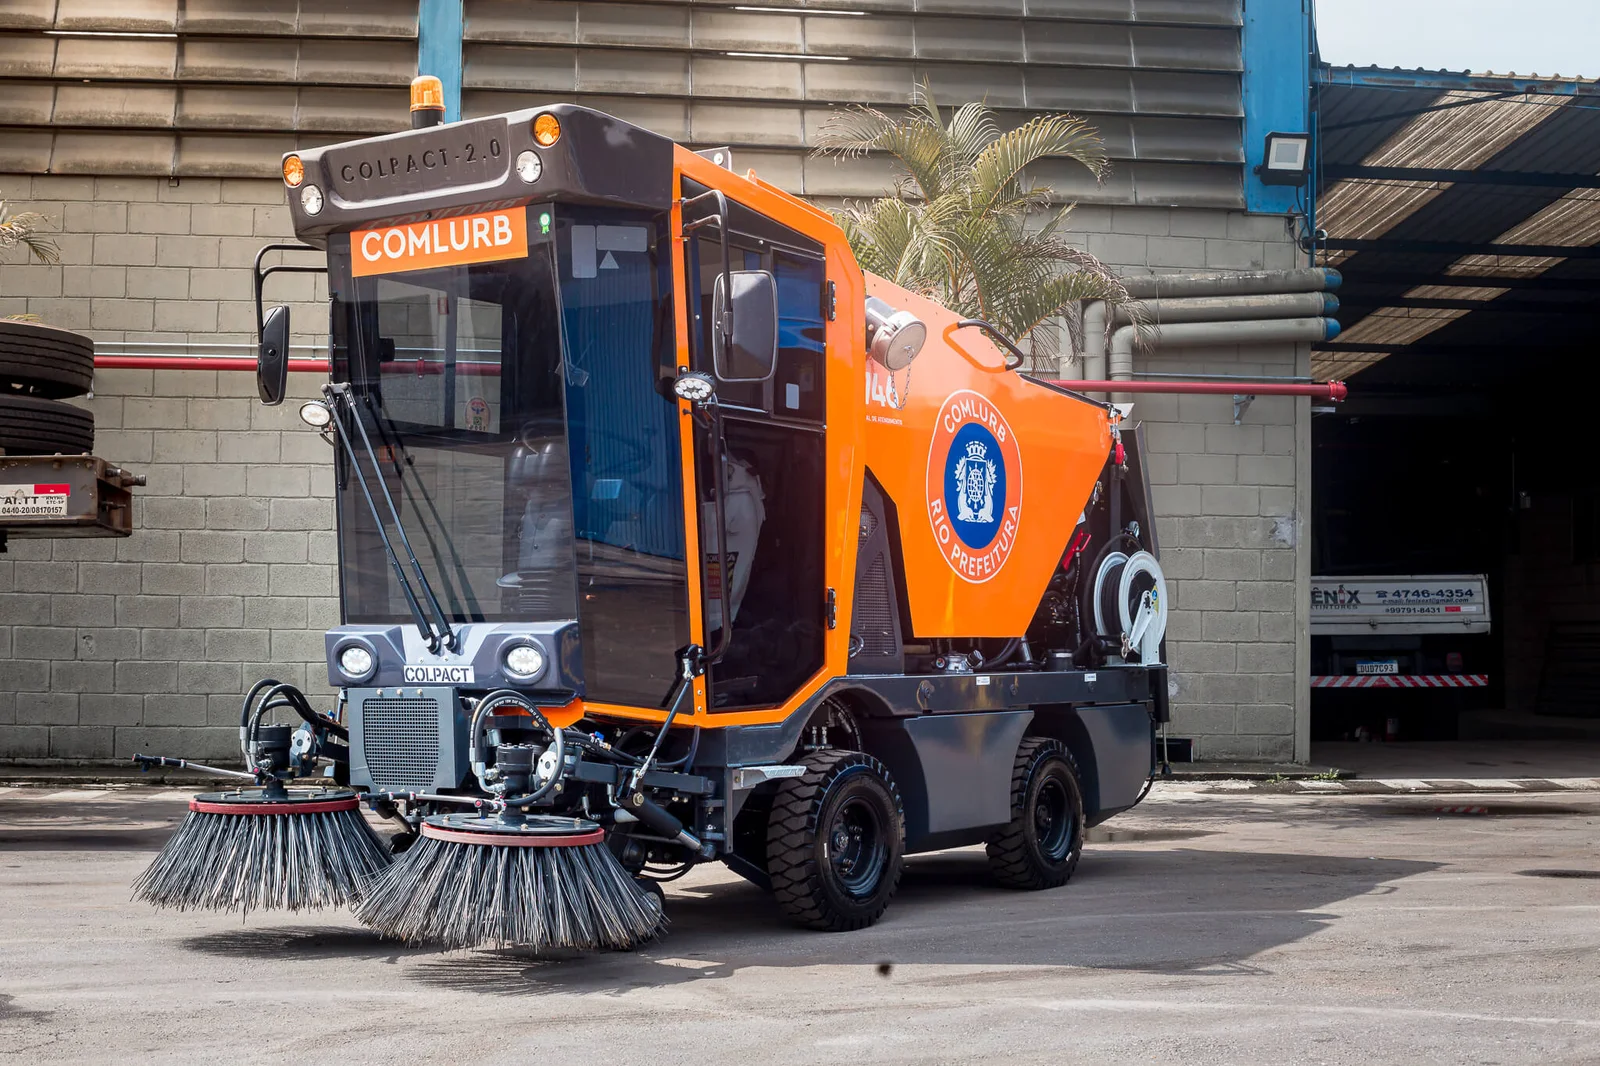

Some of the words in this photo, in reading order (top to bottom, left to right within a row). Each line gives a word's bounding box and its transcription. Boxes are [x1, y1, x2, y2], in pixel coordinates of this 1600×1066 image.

[341, 138, 500, 183] COLPACT-2.0
[361, 214, 513, 262] COMLURB
[944, 399, 1006, 443] COMLURB
[931, 498, 950, 544] RIO
[950, 506, 1018, 577] PREFEITURA
[1392, 588, 1474, 598] 4746-4354
[405, 667, 470, 682] COLPACT
